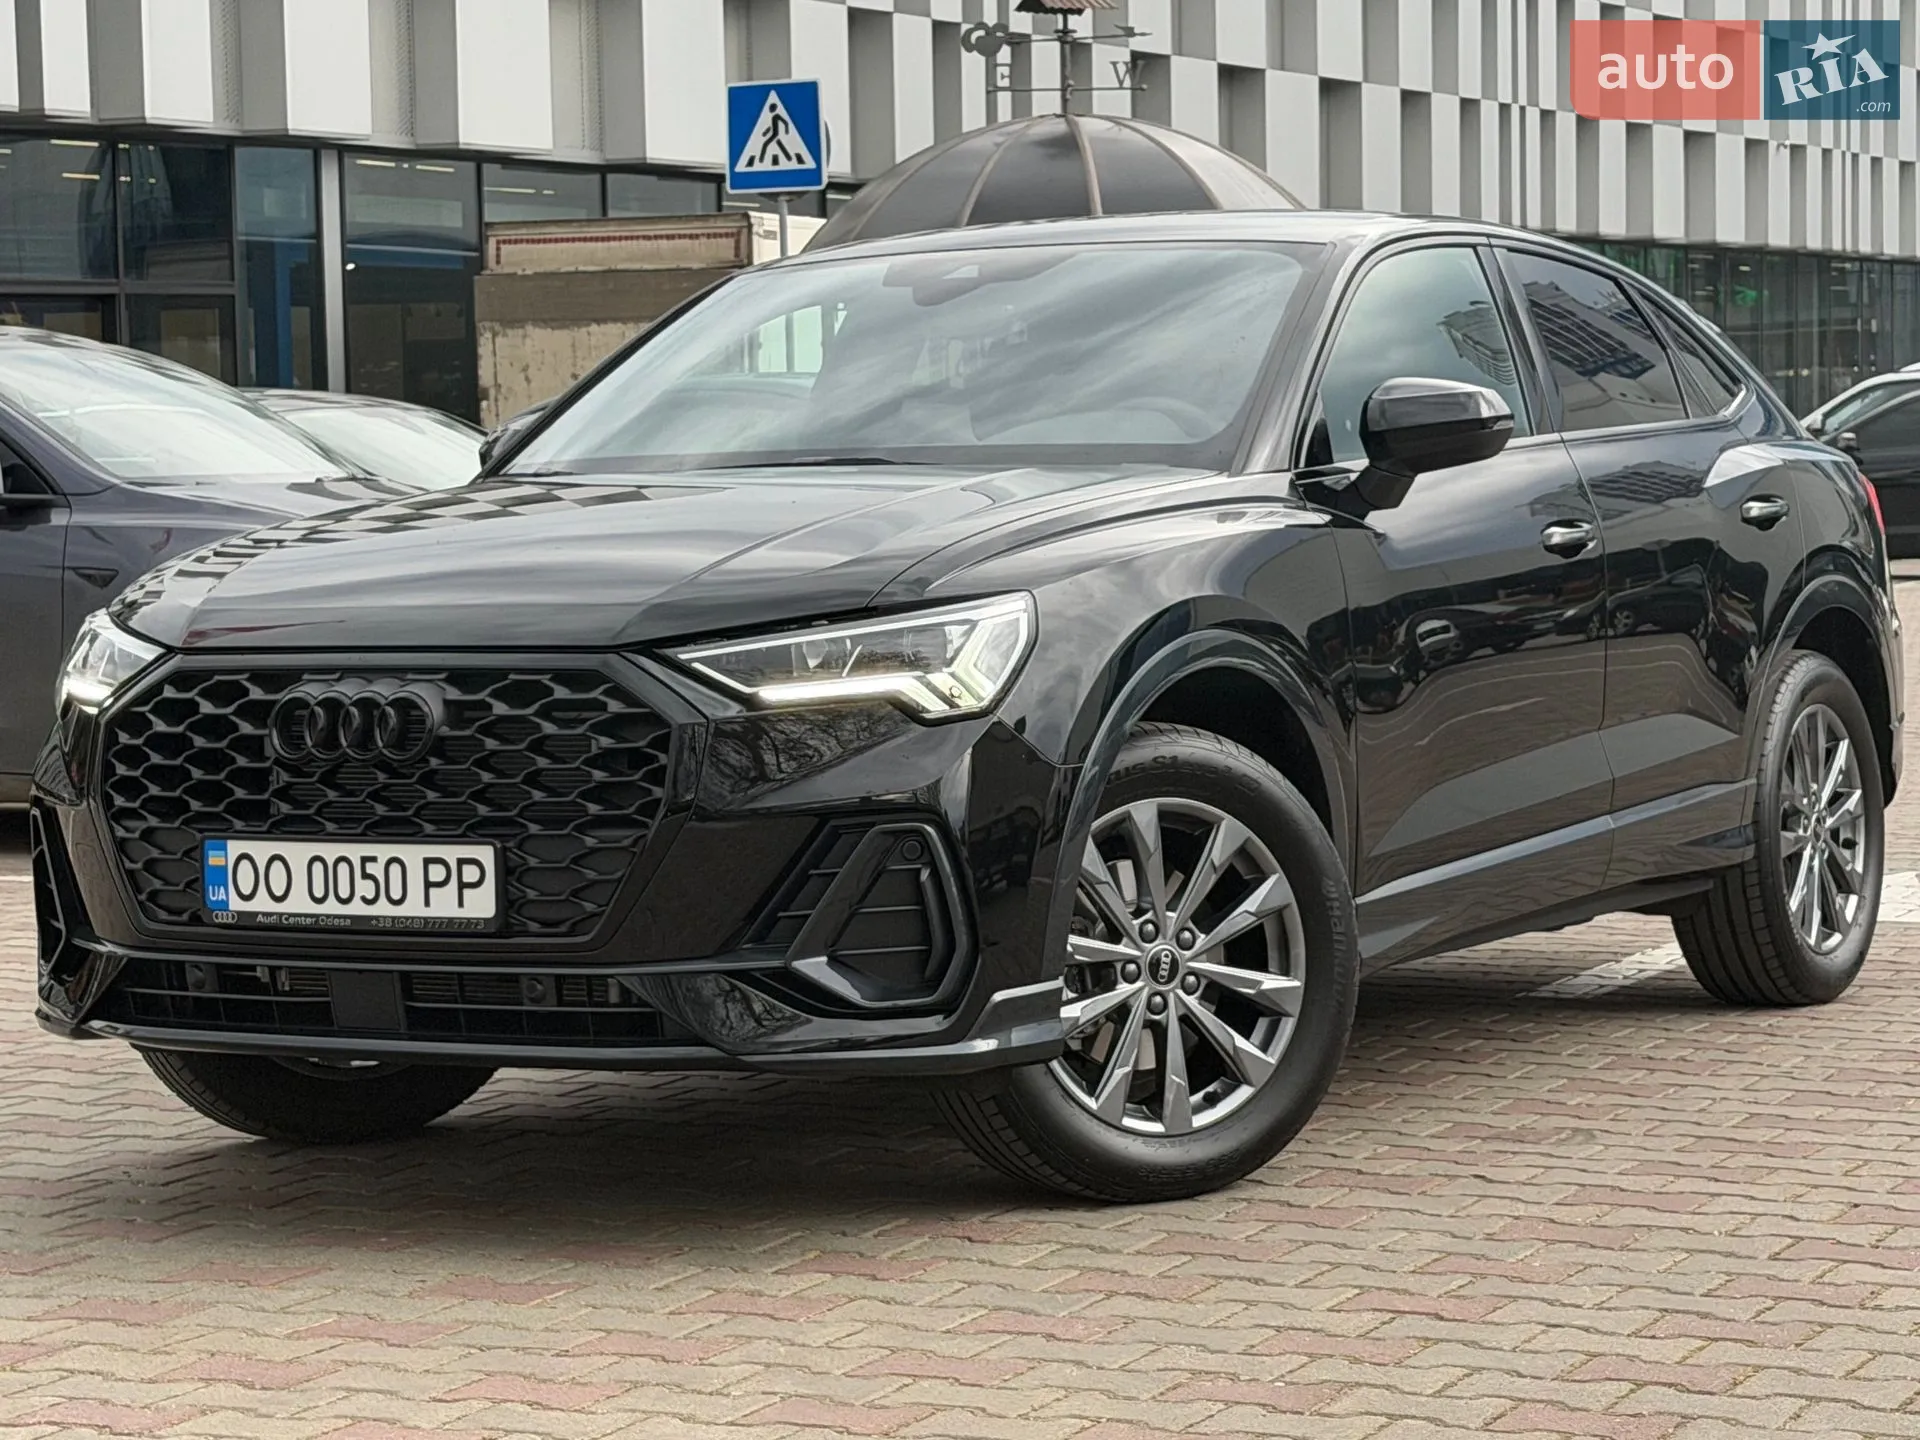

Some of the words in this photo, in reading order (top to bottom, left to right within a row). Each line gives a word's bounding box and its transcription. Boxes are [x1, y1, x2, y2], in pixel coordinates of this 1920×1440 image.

[231, 852, 293, 903] OO
[307, 855, 407, 906] 0050
[422, 856, 487, 908] PP
[209, 885, 227, 901] UA
[256, 913, 279, 925] Audi
[282, 914, 317, 926] Center
[319, 915, 351, 927] Odesa
